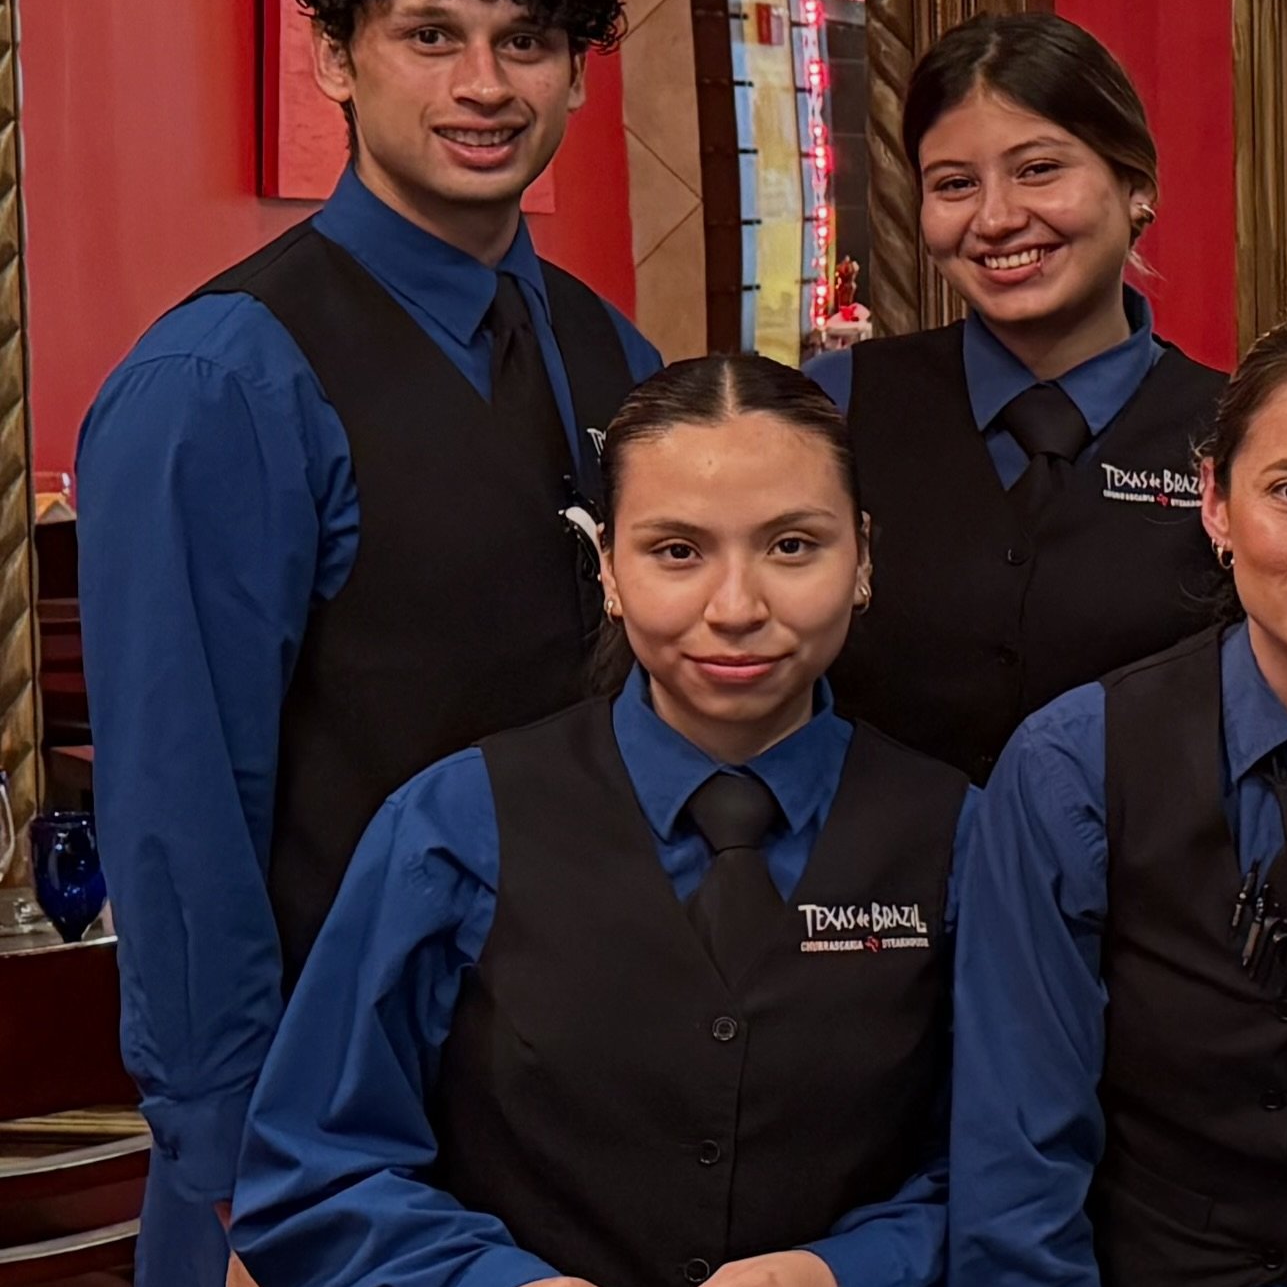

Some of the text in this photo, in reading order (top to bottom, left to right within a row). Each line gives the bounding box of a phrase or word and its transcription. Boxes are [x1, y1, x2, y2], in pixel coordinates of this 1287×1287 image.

[1101, 463, 1204, 494] TEXAS de BRAZ
[798, 902, 928, 938] TEXAS de BRAZIL
